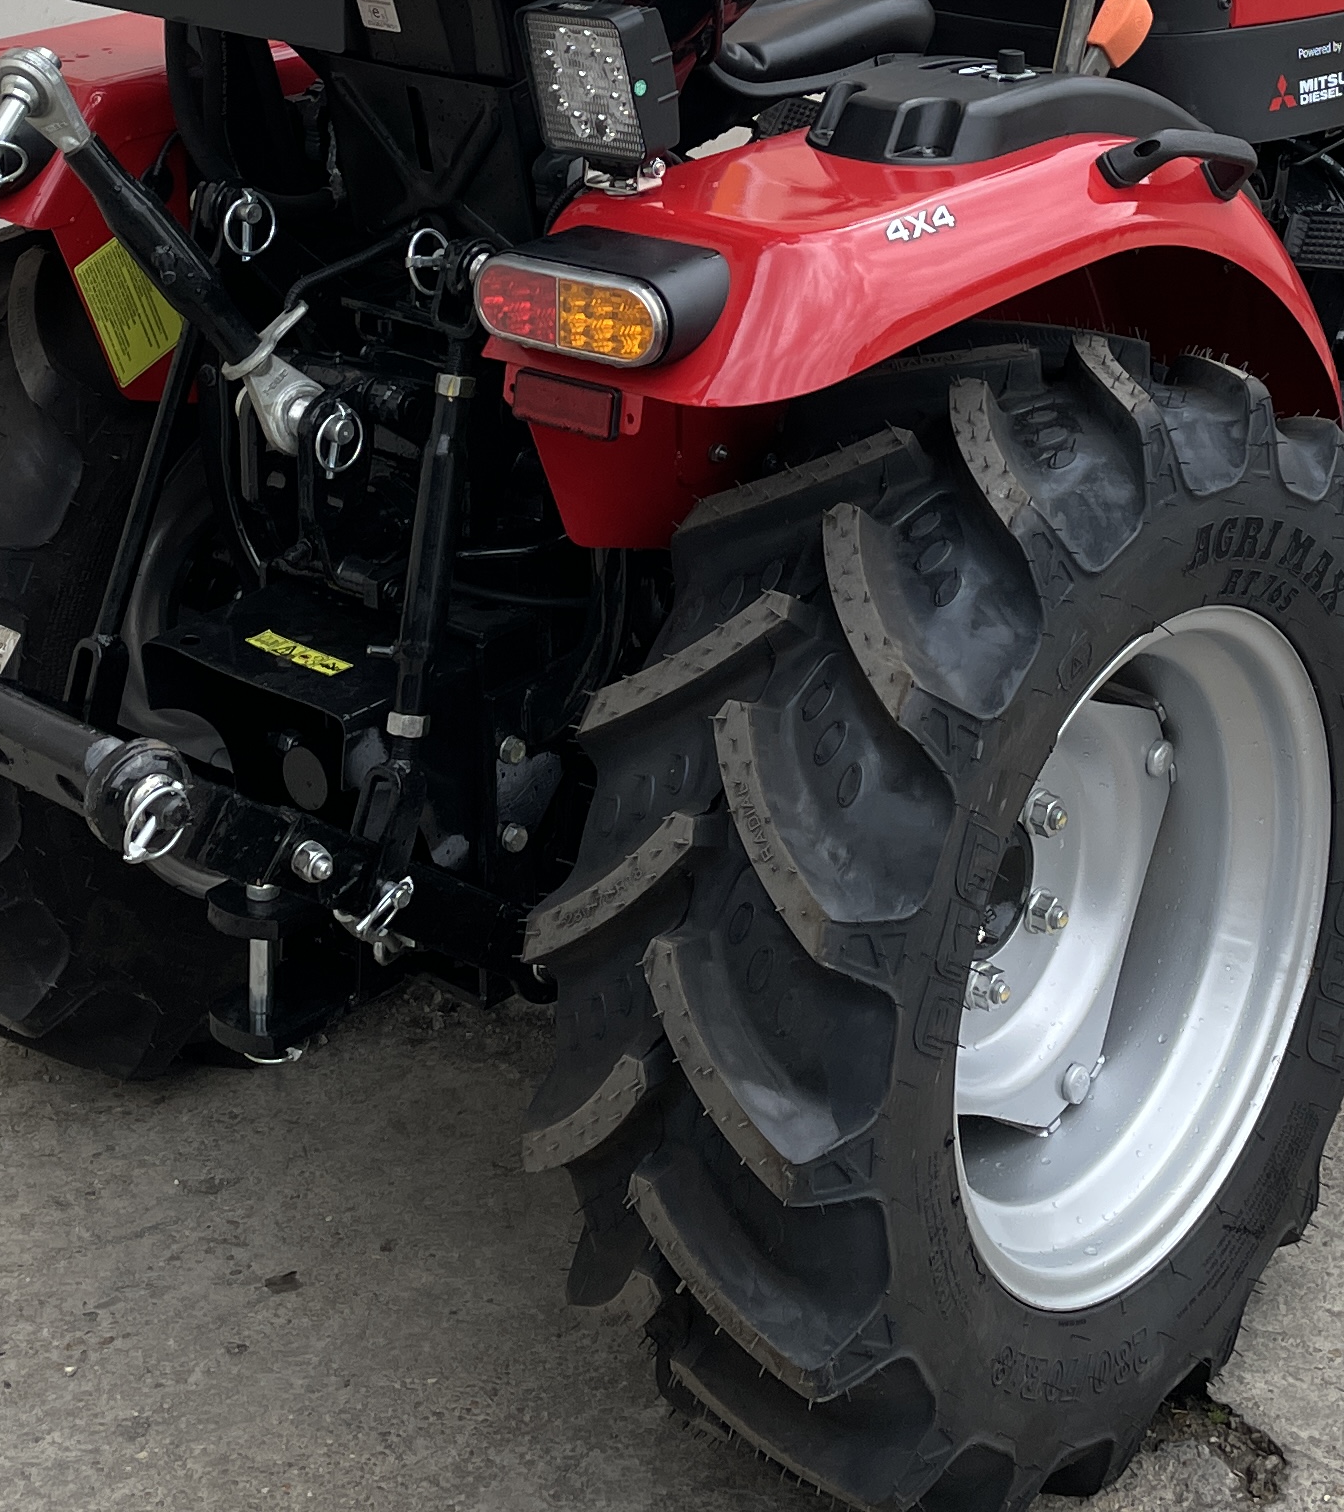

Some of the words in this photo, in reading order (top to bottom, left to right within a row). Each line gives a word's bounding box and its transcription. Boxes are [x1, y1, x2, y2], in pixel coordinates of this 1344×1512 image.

[1298, 41, 1331, 59] Powered
[1332, 40, 1343, 54] by
[1300, 86, 1343, 106] DIESEL
[886, 204, 956, 241] 4X4
[736, 783, 774, 863] RADIAL
